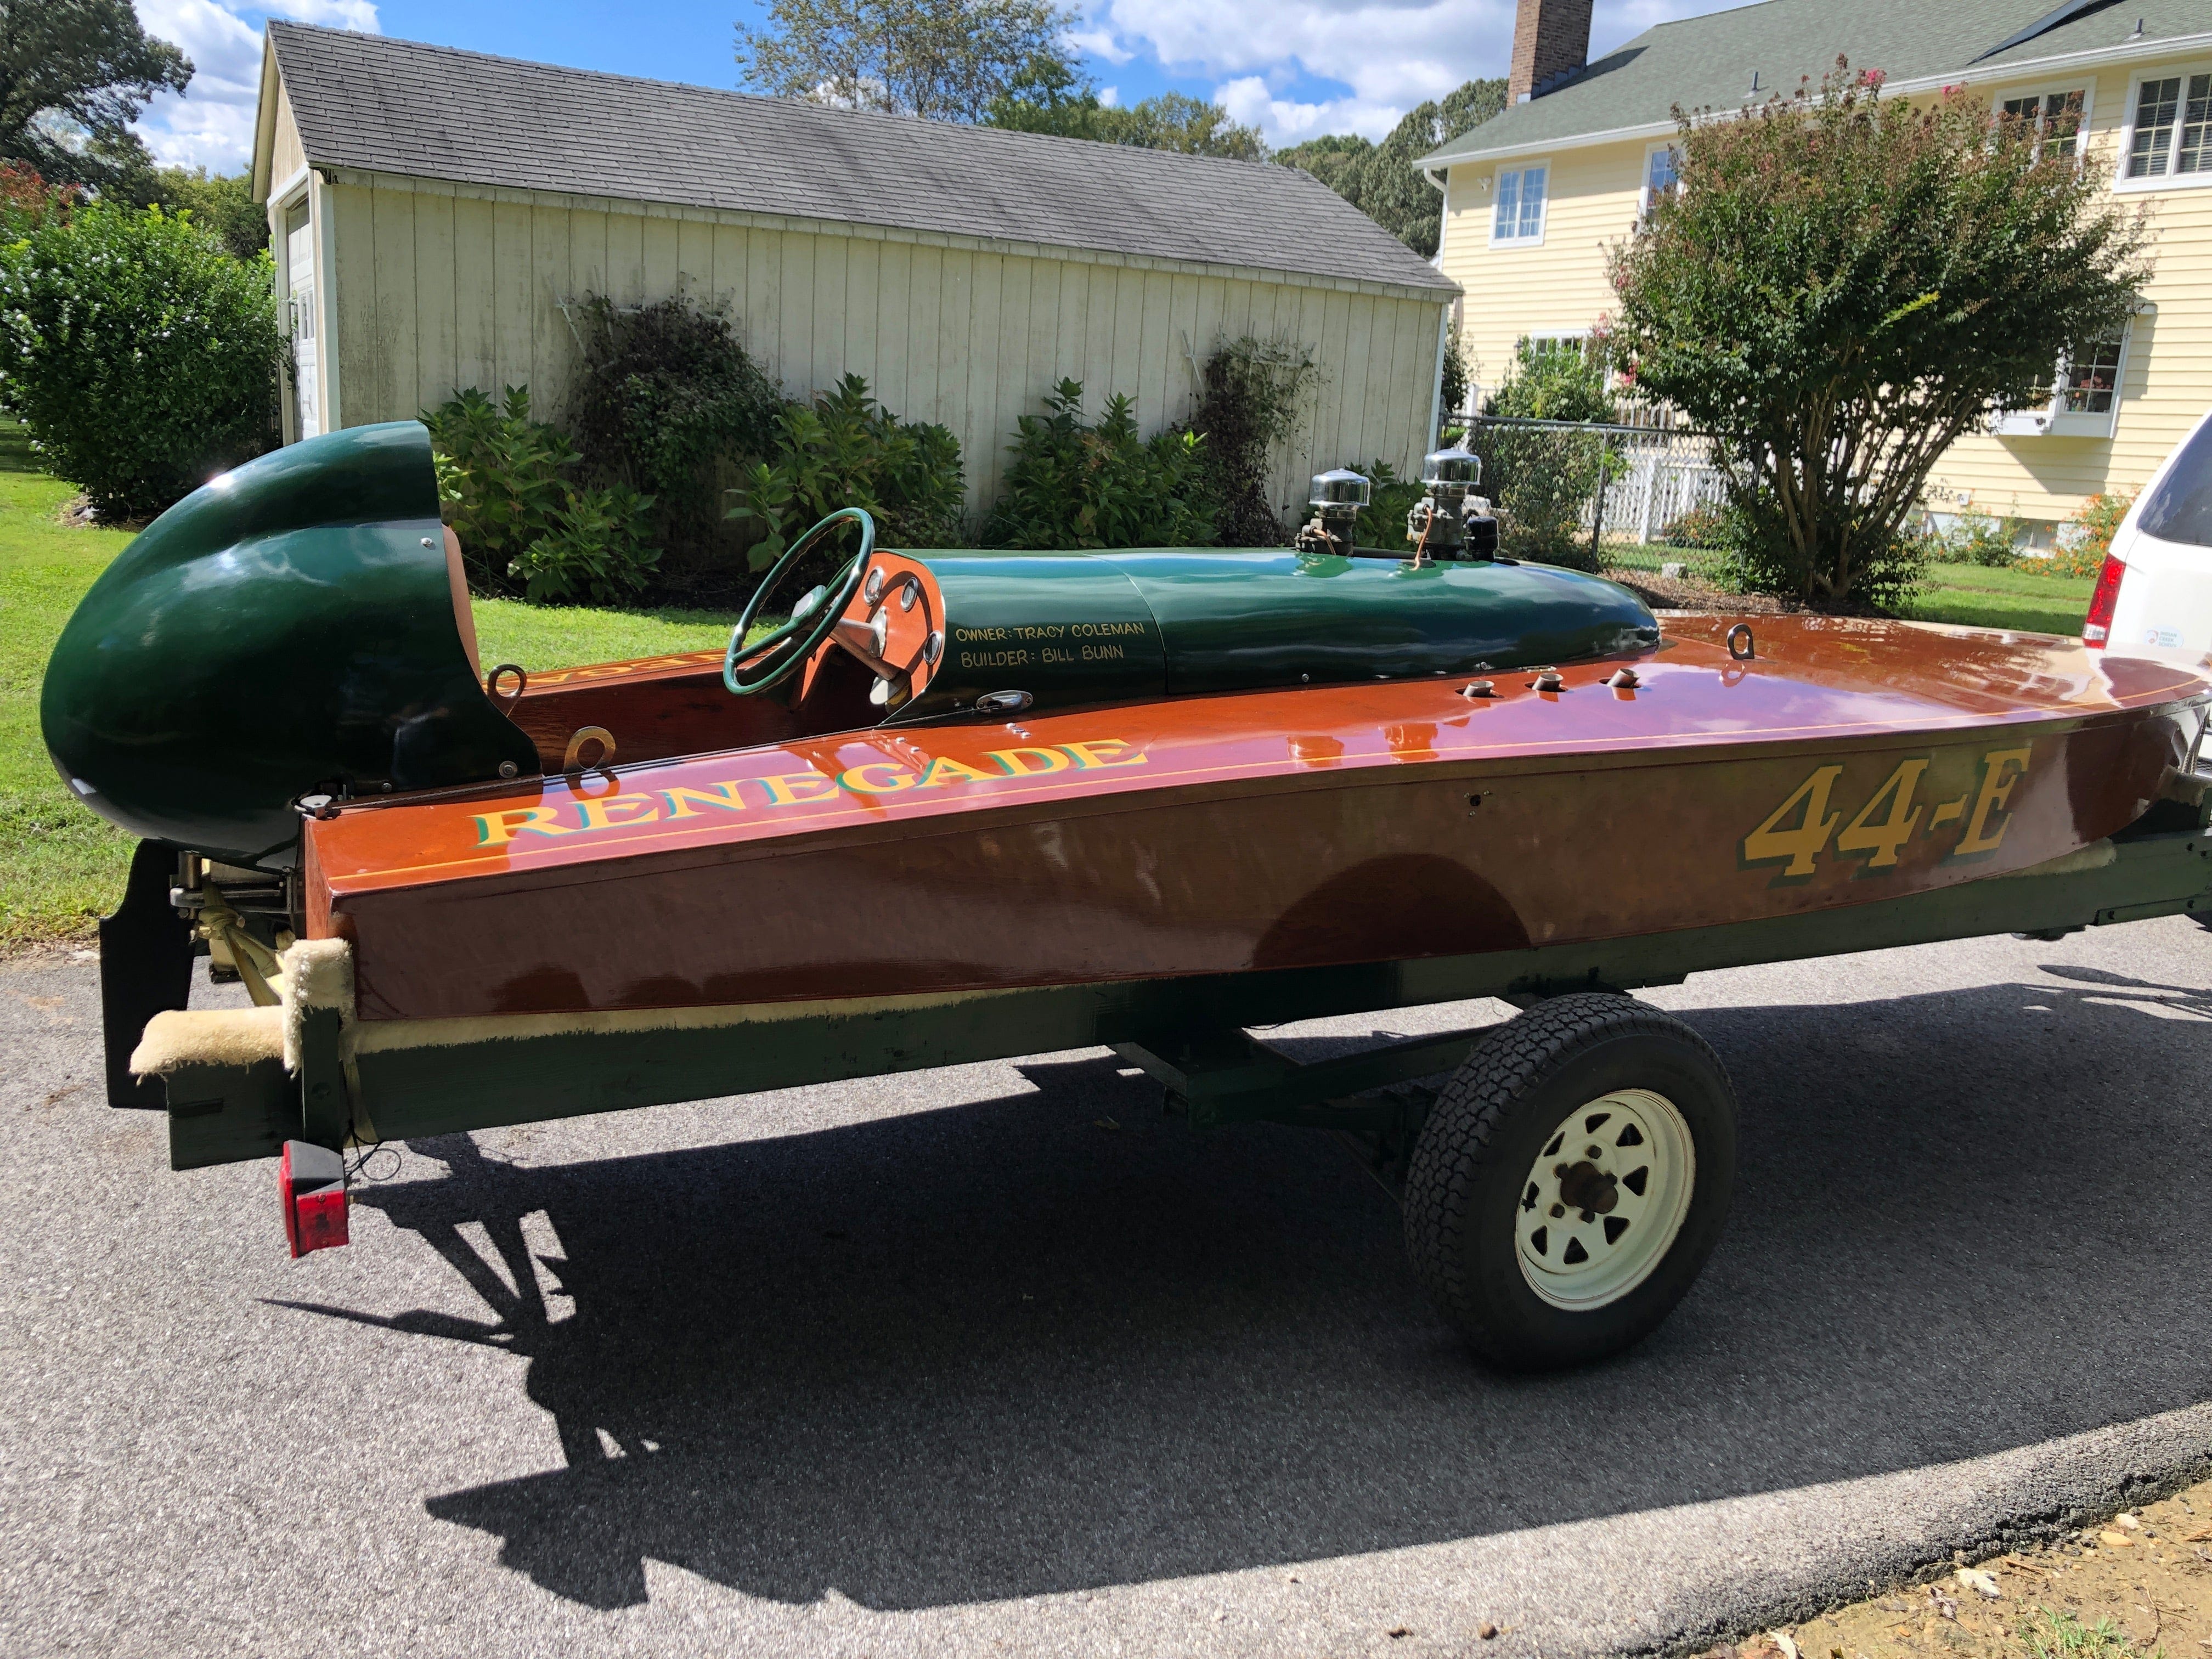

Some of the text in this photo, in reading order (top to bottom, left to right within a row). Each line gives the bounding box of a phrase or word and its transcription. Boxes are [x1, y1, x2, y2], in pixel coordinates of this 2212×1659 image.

[955, 622, 1145, 641] OWNER: TRACY COLEMAN
[961, 644, 1124, 668] BUILDER: BILL BUNN
[469, 738, 1148, 848] RENEGADE
[1739, 747, 2032, 883] 44-E
